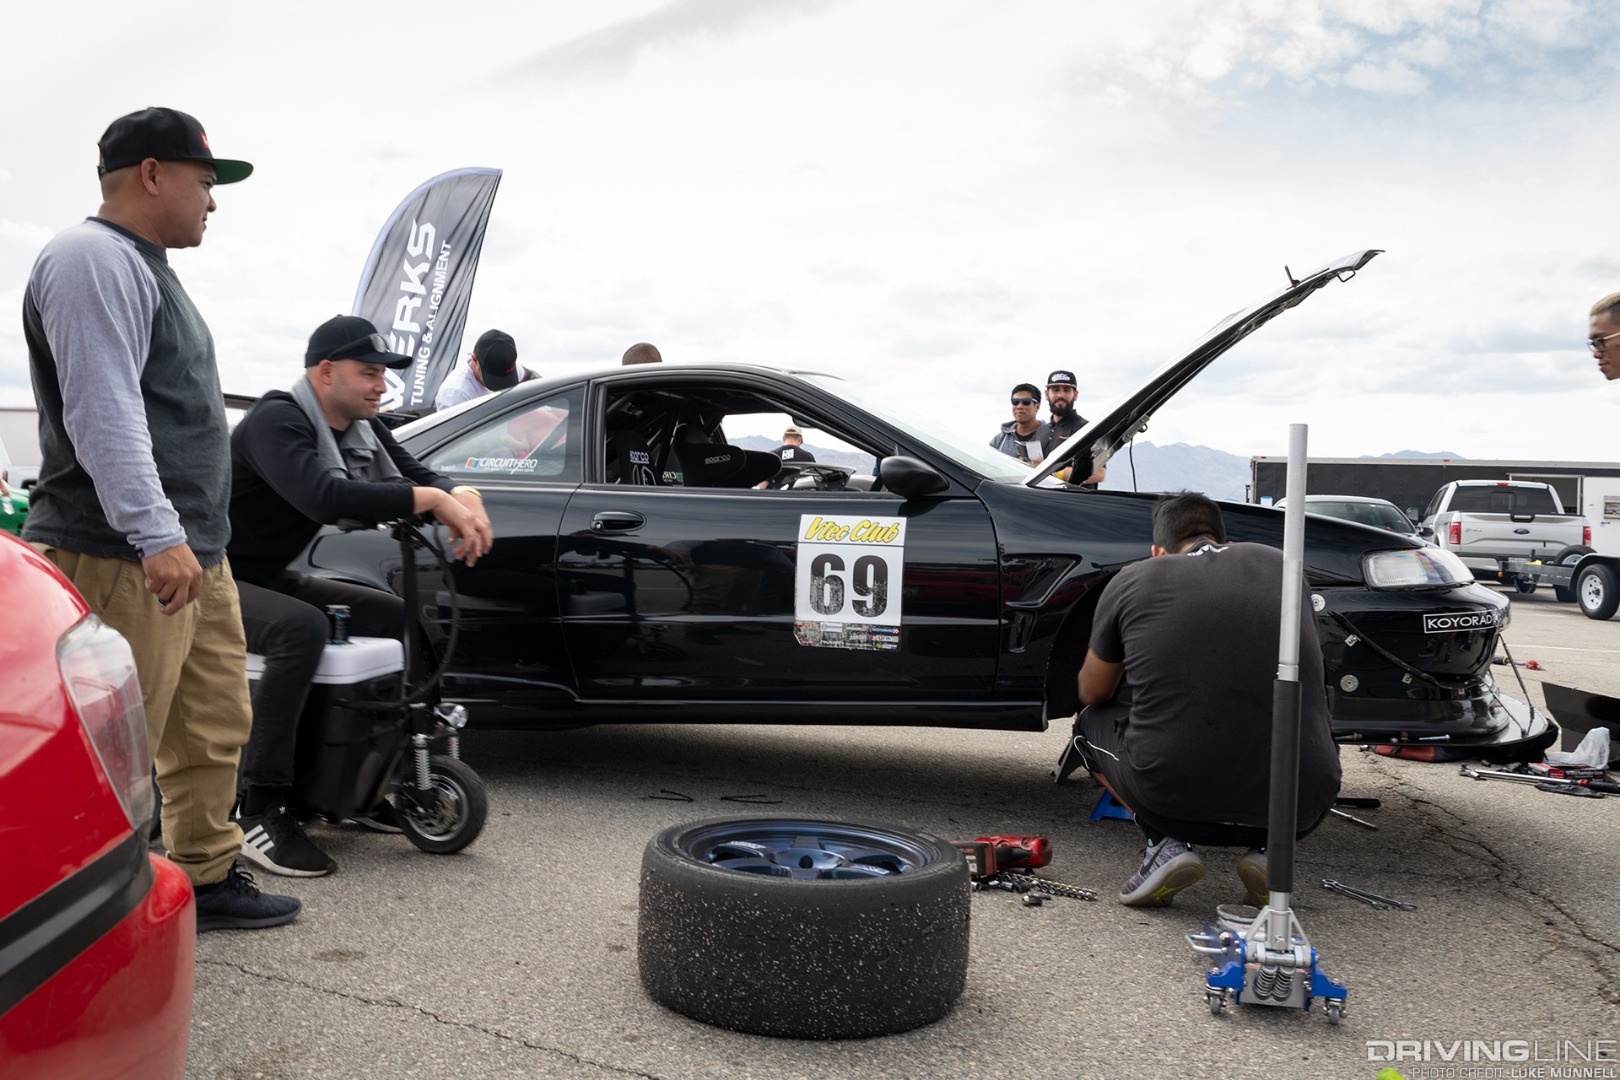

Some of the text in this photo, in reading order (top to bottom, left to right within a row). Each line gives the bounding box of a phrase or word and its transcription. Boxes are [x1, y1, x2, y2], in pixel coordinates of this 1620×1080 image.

[410, 239, 452, 406] TUNING & ALIGNMENT
[804, 517, 900, 543] Vtec Club
[809, 553, 888, 618] 69
[1427, 614, 1493, 629] KOYORAD
